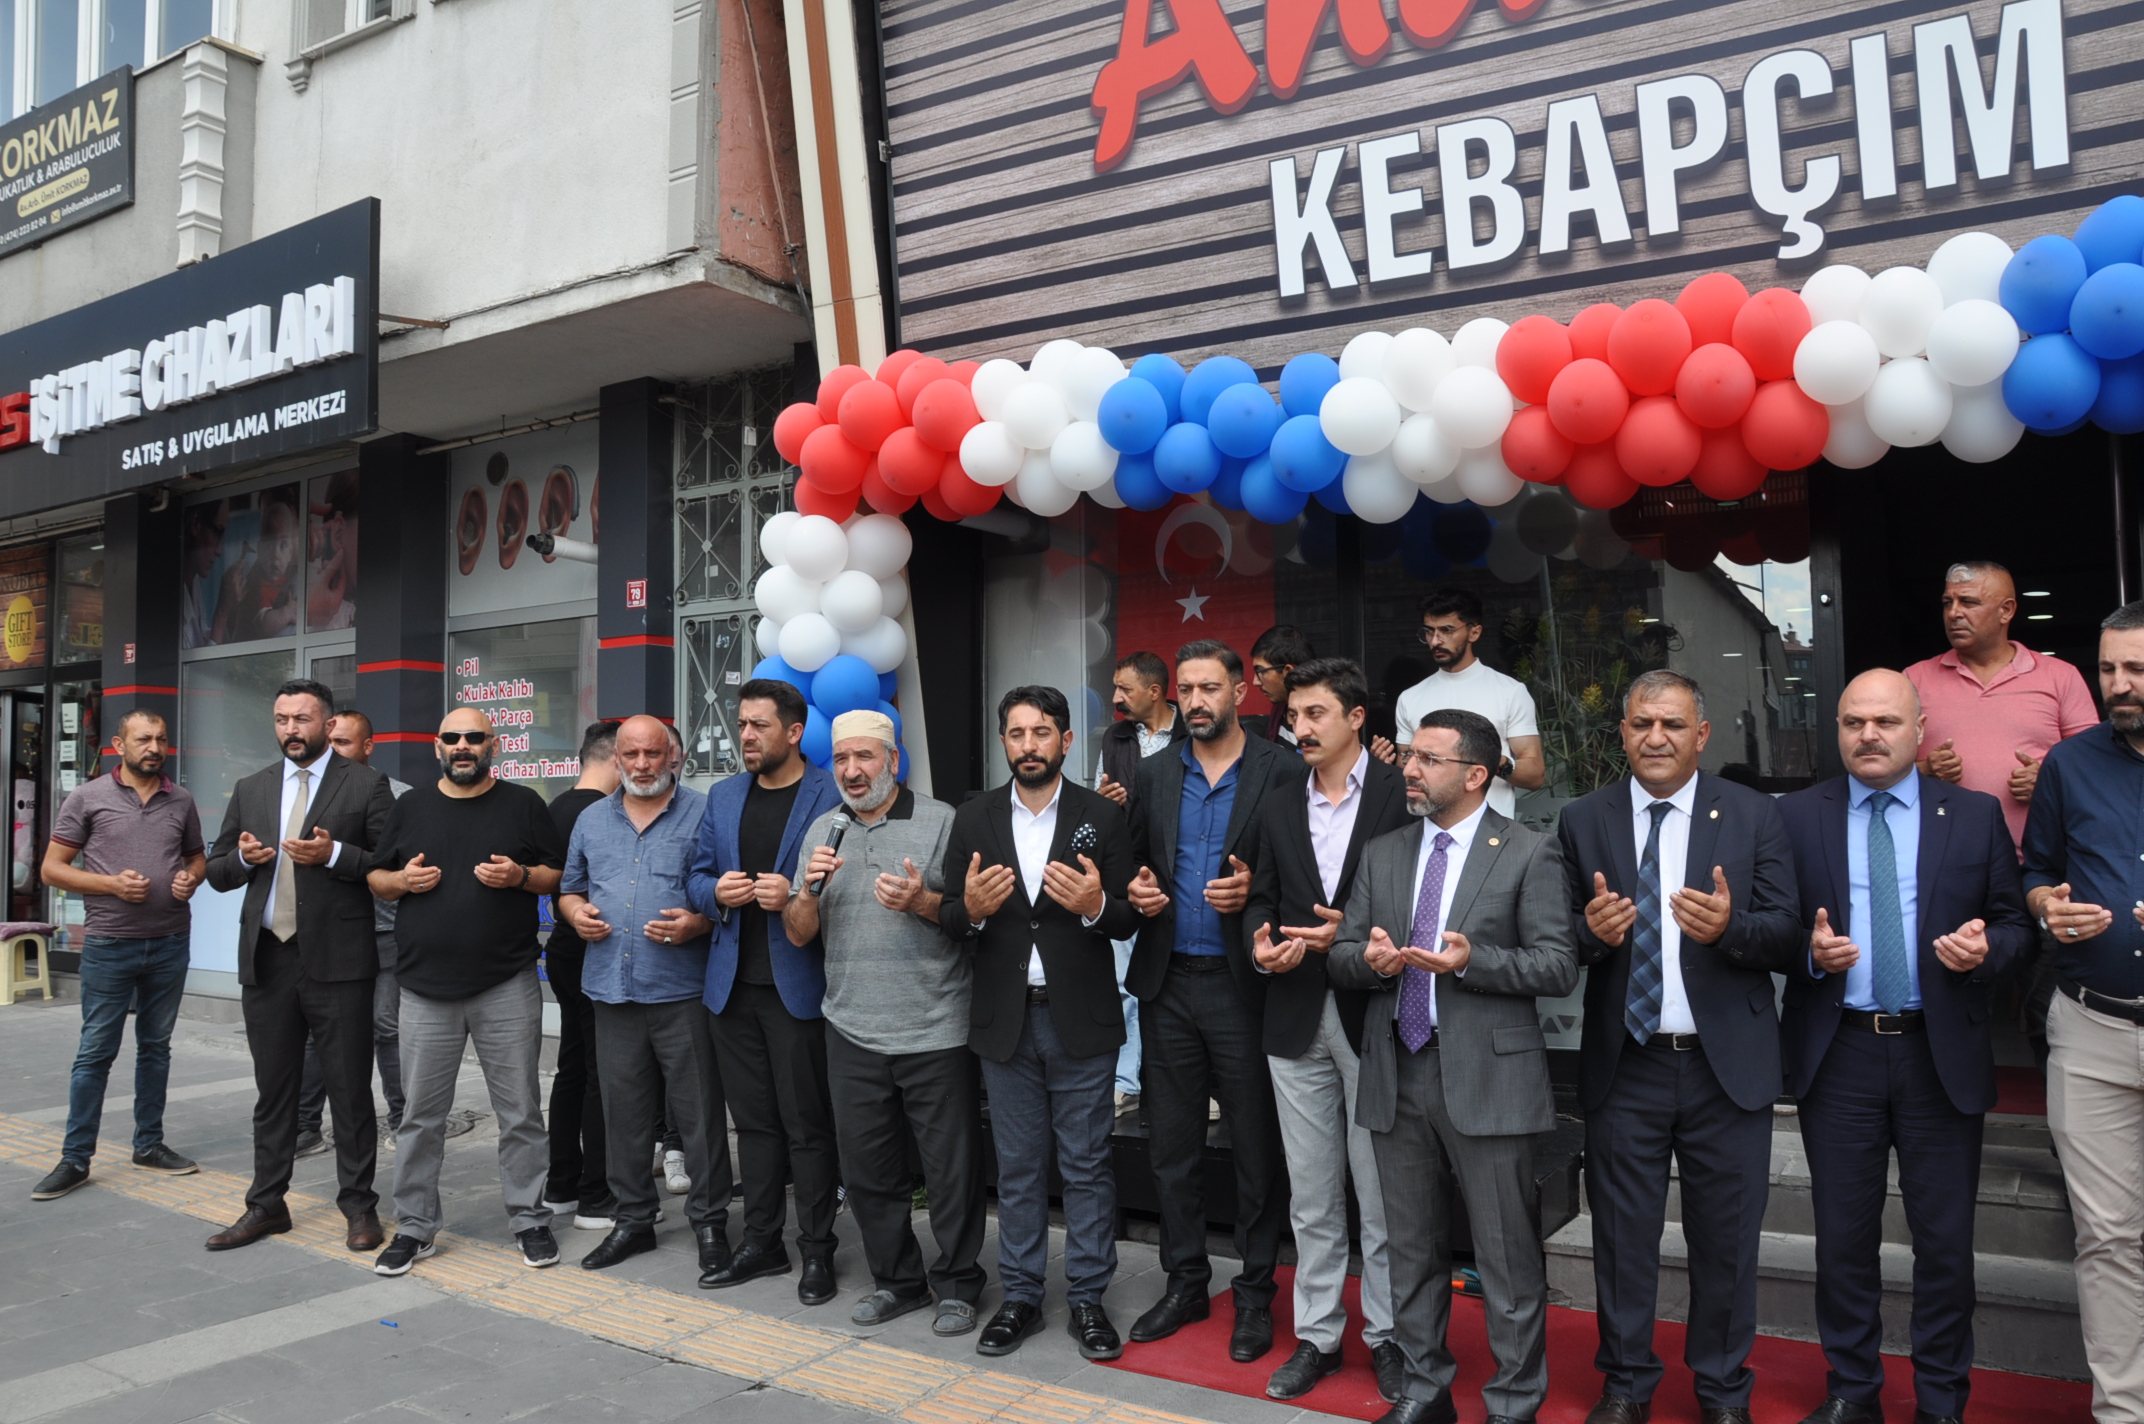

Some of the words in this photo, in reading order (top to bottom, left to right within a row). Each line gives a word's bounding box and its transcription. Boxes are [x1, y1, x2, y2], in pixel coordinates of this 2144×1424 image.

[0, 88, 120, 182] ORKMAZ
[37, 169, 44, 184] &
[45, 132, 121, 180] ARABULUCULUK
[1269, 0, 2073, 300] KEBAPÇIM
[56, 174, 88, 196] KORKMAZ
[19, 223, 30, 236] 223
[0, 391, 31, 450] S
[30, 348, 141, 454] İŞİTME
[141, 275, 354, 412] CİHAZLARI
[122, 440, 164, 470] SATIŞ
[168, 436, 179, 459] &
[183, 412, 270, 454] UYGULAMA
[274, 389, 346, 431] MERKEZİ
[630, 588, 641, 600] 79
[8, 611, 33, 633] GIFT
[8, 632, 32, 648] STORE
[464, 658, 479, 677] Pil
[463, 681, 496, 703] Kulak
[498, 678, 533, 700] Kalıbı
[500, 708, 533, 729] Parça
[501, 732, 529, 753] Testi
[501, 759, 538, 779] Cihazı
[540, 756, 580, 778] Tamiri
